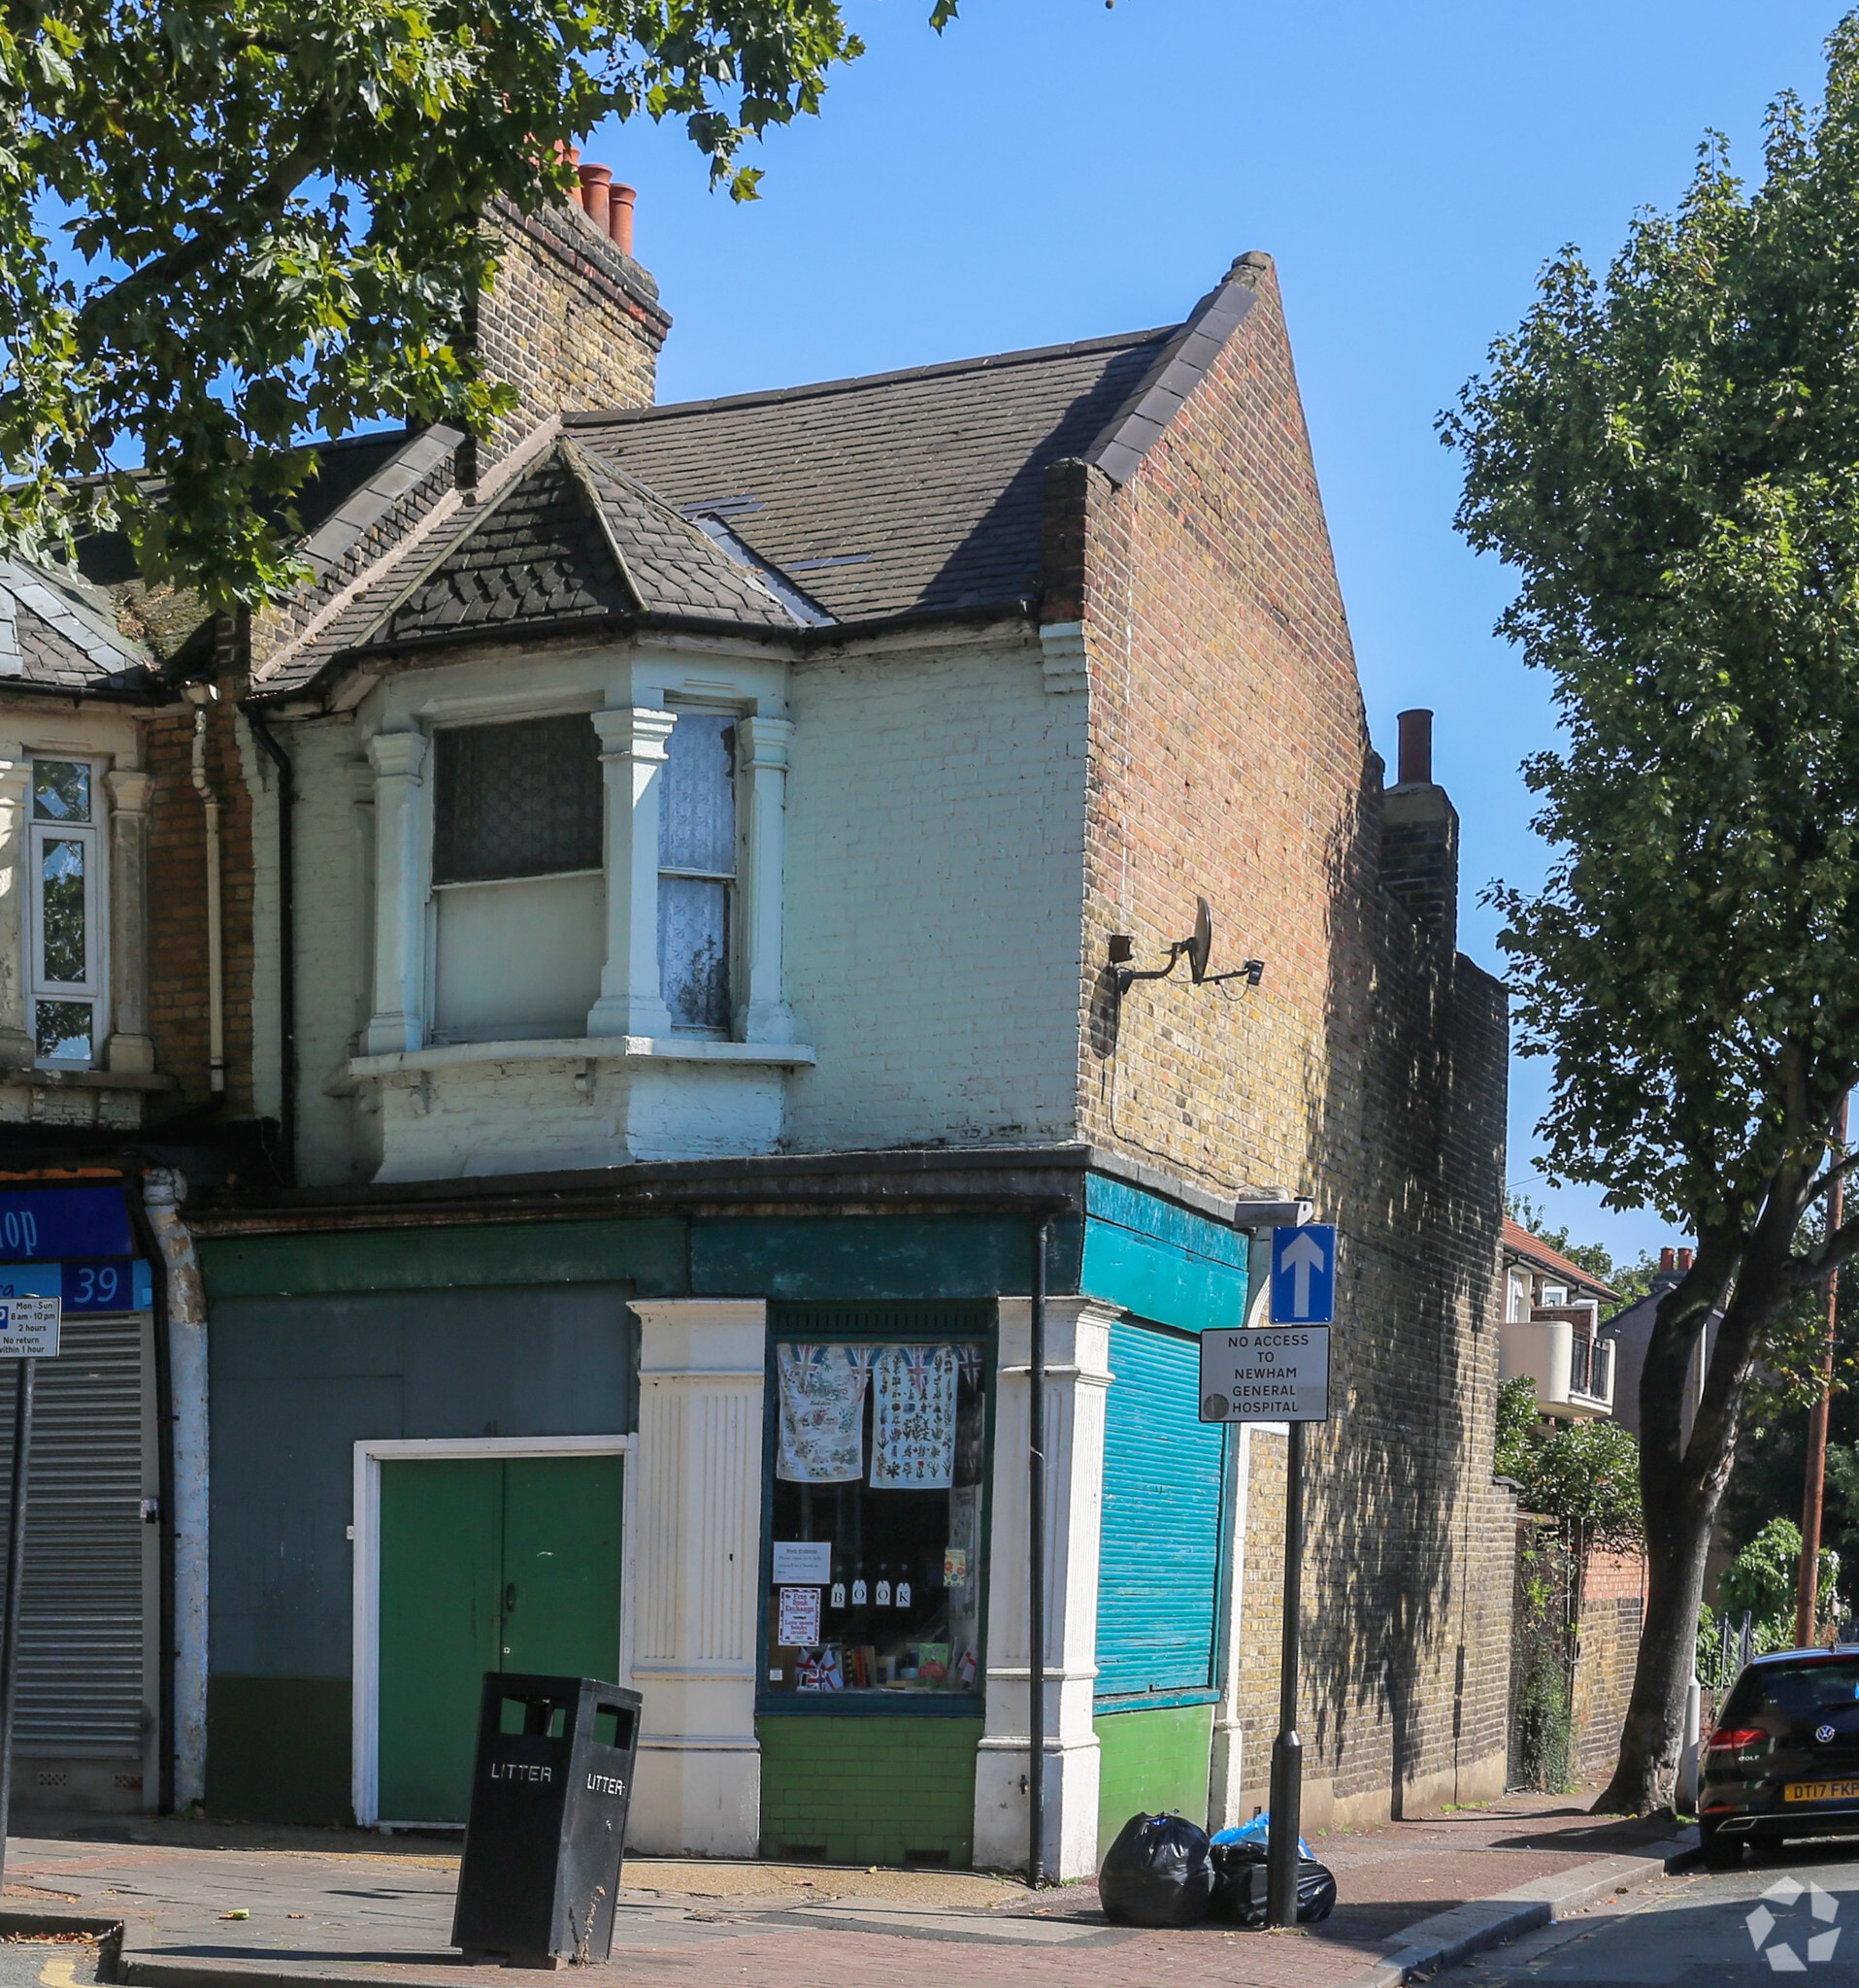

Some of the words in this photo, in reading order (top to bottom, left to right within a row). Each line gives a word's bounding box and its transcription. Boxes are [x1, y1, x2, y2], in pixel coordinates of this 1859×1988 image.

[74, 1267, 117, 1303] 39
[1228, 1337, 1248, 1347] NO
[1254, 1335, 1309, 1347] ACCESS
[1257, 1352, 1275, 1363] TO
[1234, 1367, 1297, 1379] NEWHAM
[1233, 1385, 1296, 1397] GENERAL
[1232, 1402, 1299, 1413] HOSPITAL
[491, 1763, 552, 1782] LITTER
[587, 1773, 623, 1796] LITTER
[1794, 1785, 1827, 1799] DT17
